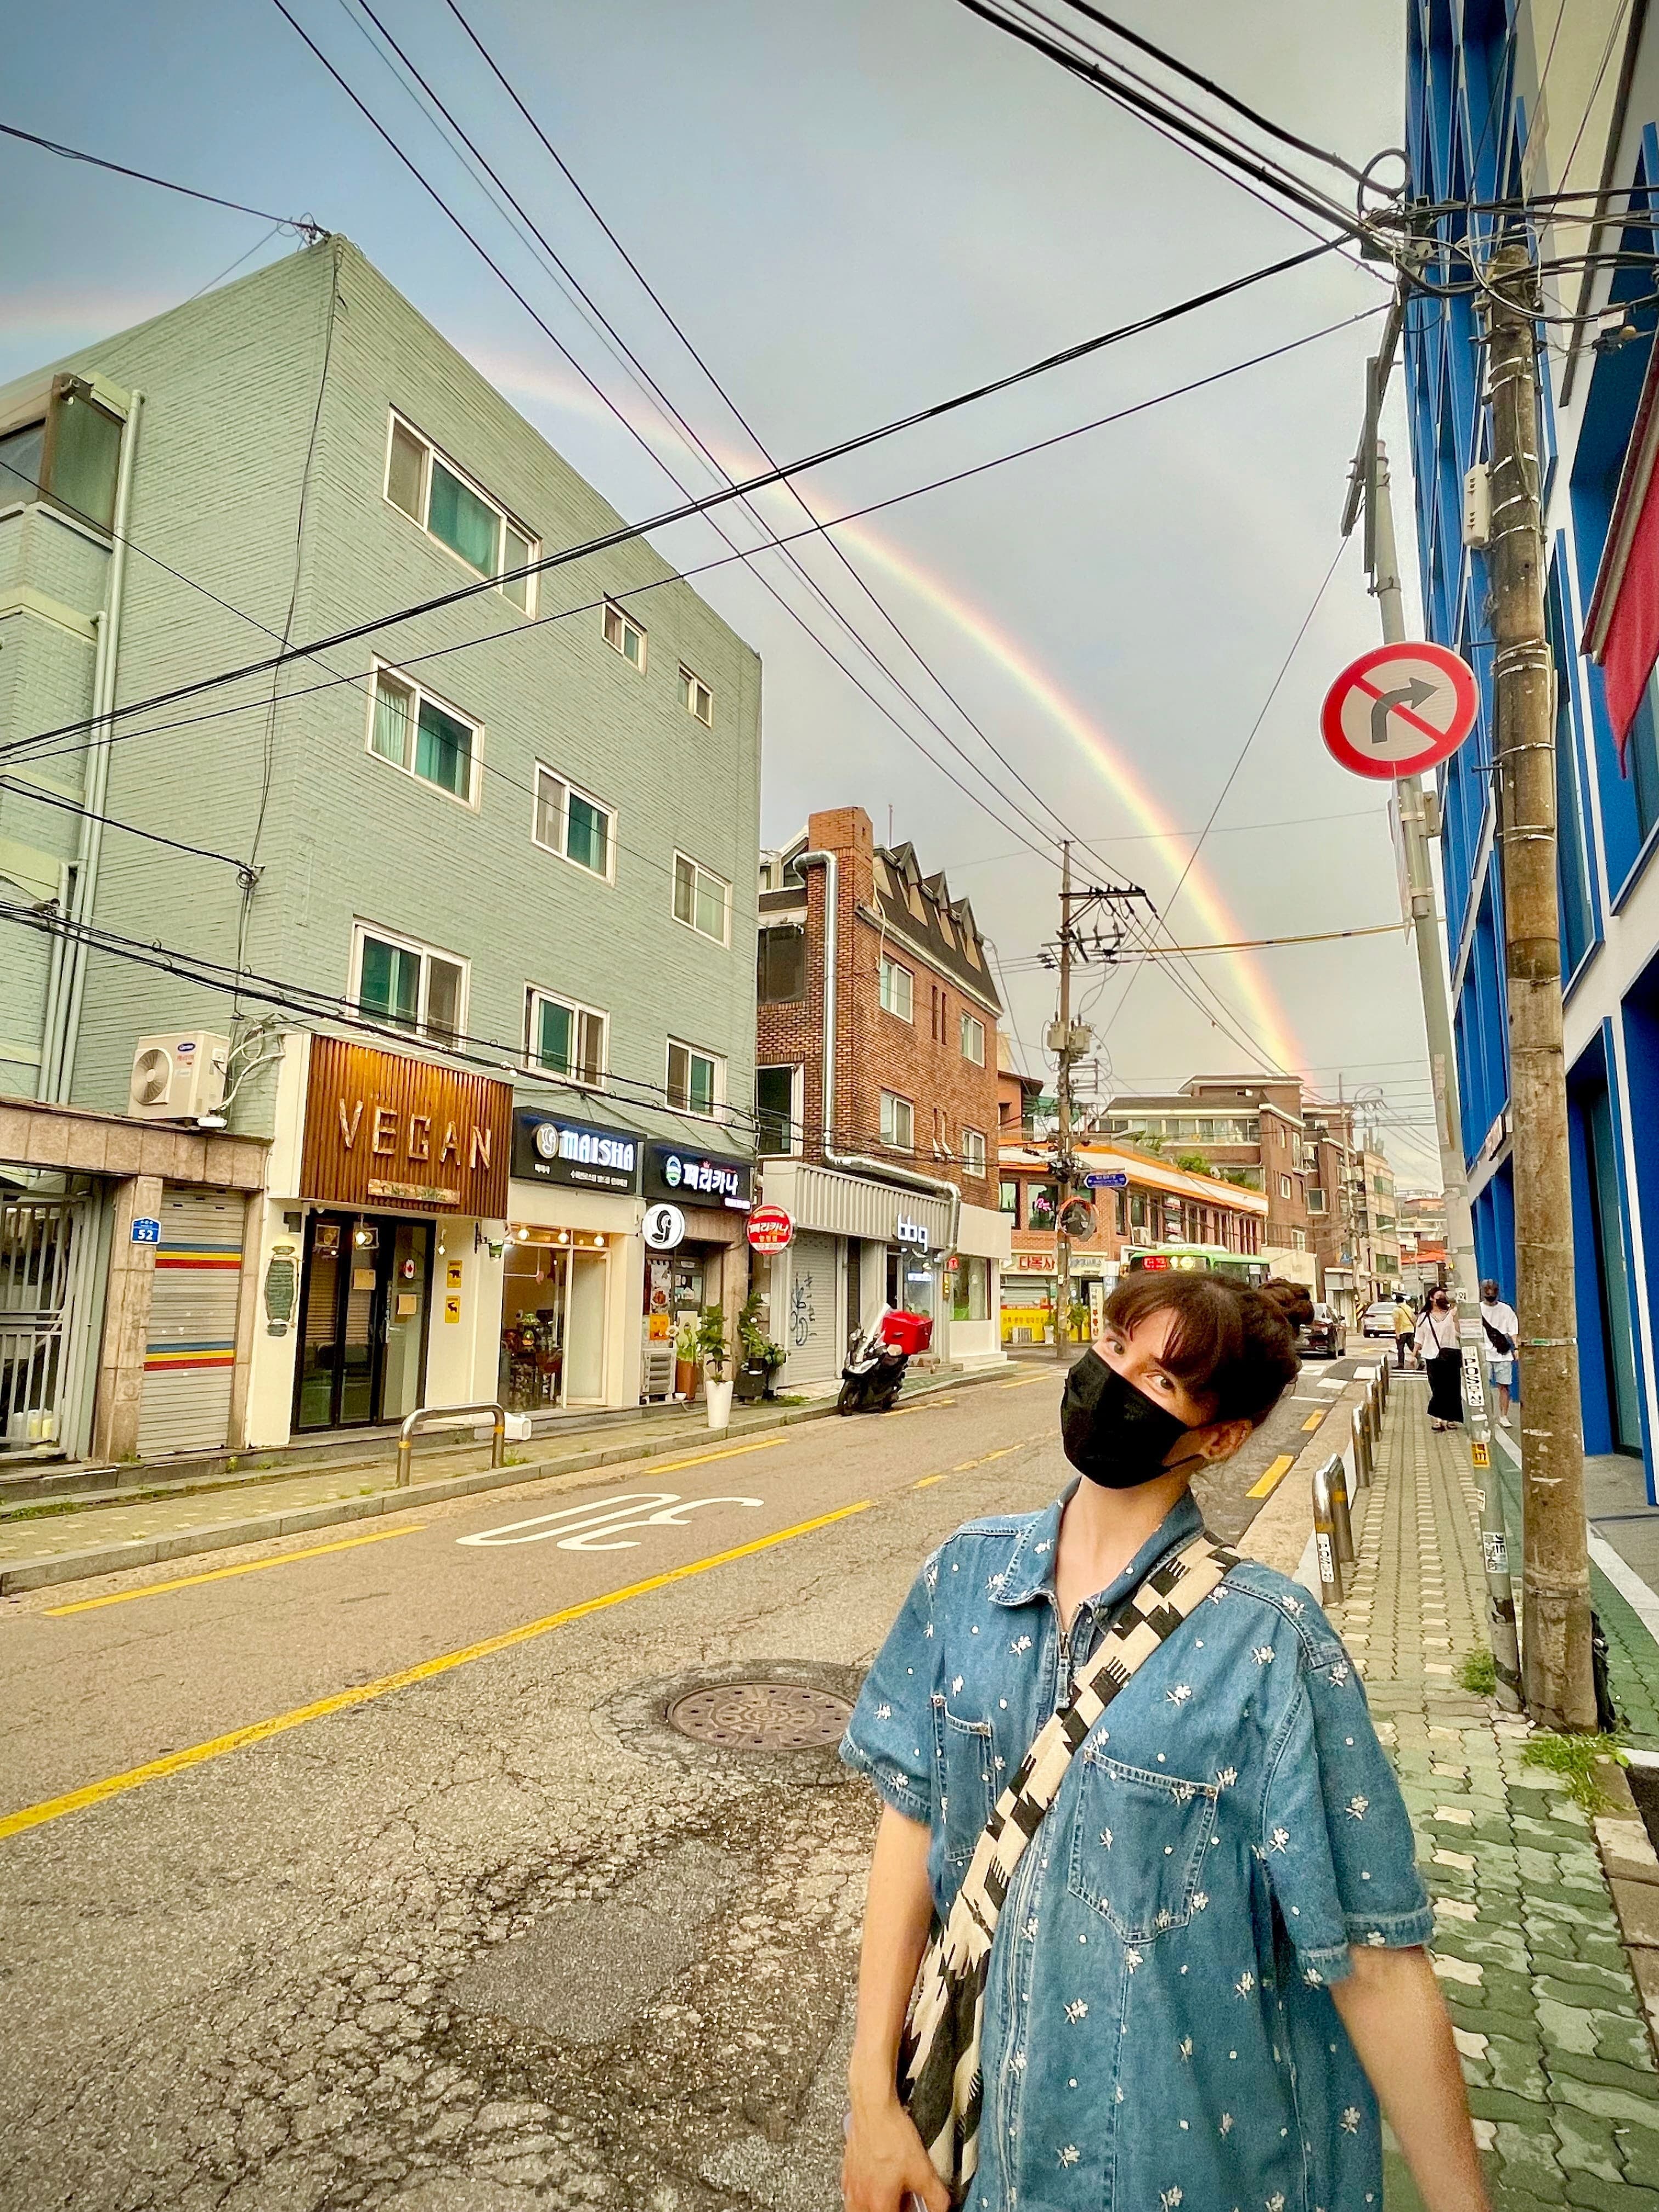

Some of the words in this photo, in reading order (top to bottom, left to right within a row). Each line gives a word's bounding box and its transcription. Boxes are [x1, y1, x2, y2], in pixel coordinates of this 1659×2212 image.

[338, 1097, 492, 1169] VEGAN
[558, 1130, 634, 1172] MAISHA
[683, 1163, 738, 1195] 페리카나
[138, 1229, 154, 1240] 52
[748, 1222, 789, 1234] 페리카나
[898, 1213, 928, 1253] bbq
